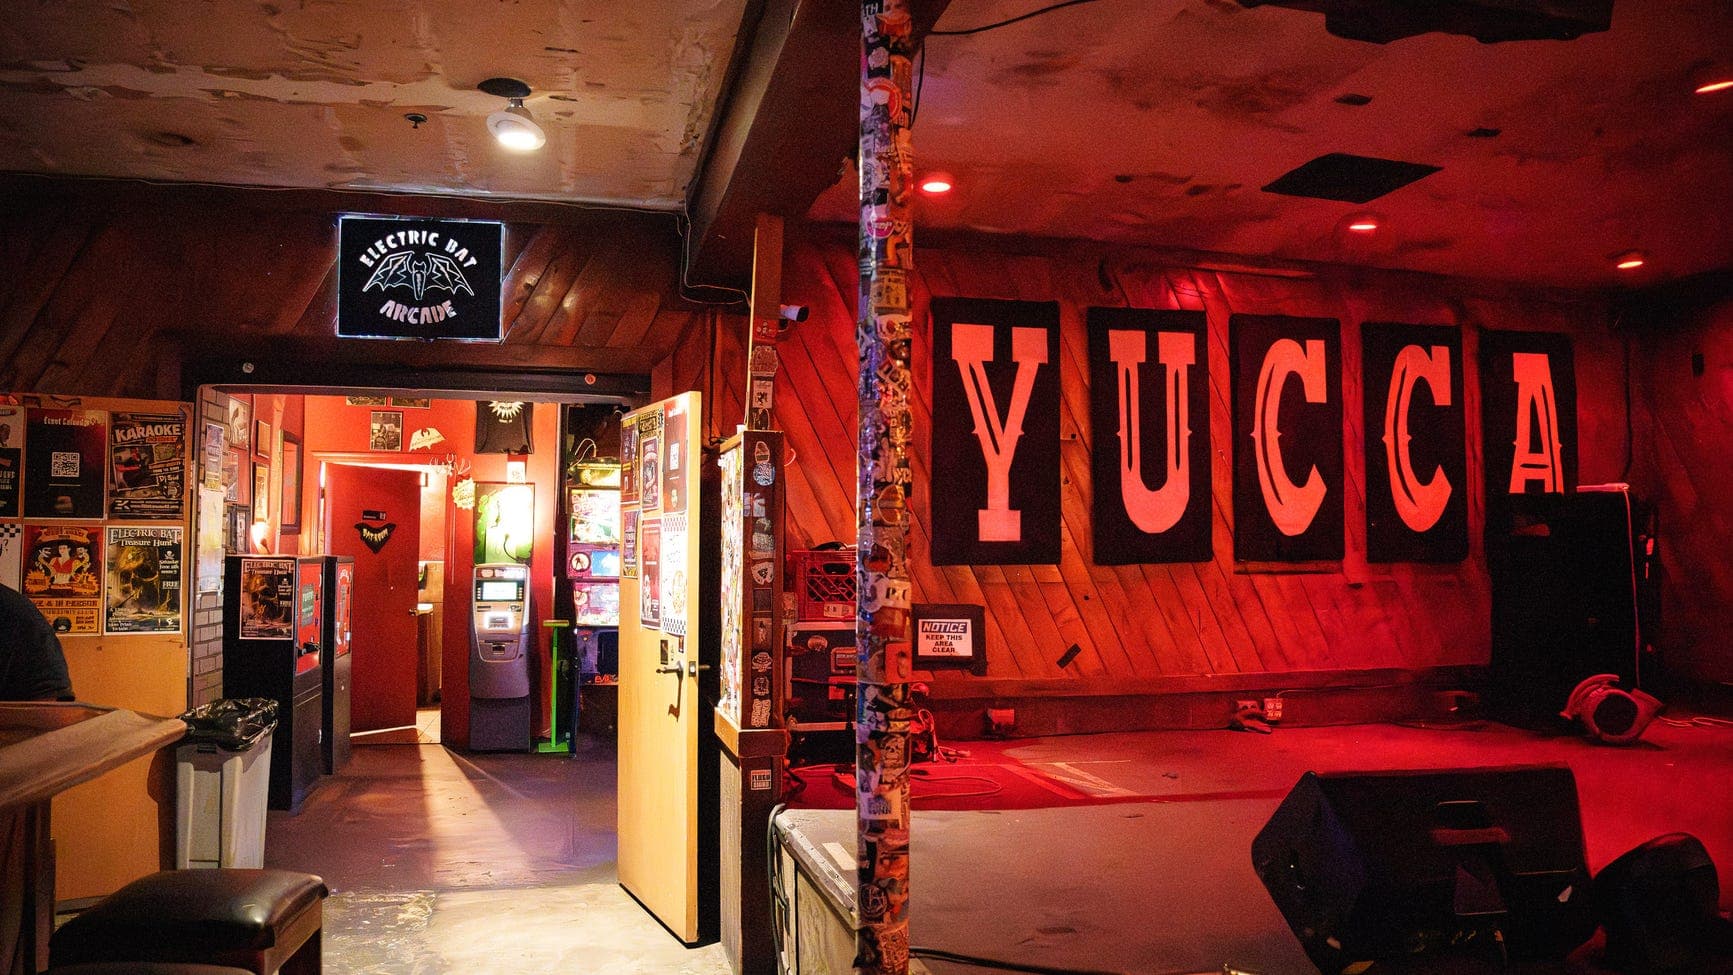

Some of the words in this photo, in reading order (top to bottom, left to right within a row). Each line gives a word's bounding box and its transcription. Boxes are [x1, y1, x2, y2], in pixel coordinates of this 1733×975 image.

[359, 230, 440, 268] ELECTRIC
[444, 238, 478, 268] BAT
[379, 300, 458, 325] ARCADE
[114, 424, 182, 442] KARAOKE
[951, 323, 1564, 541] YUCCA
[110, 529, 157, 544] ELECTRIC
[160, 529, 181, 544] BAT
[922, 622, 966, 632] NOTICE
